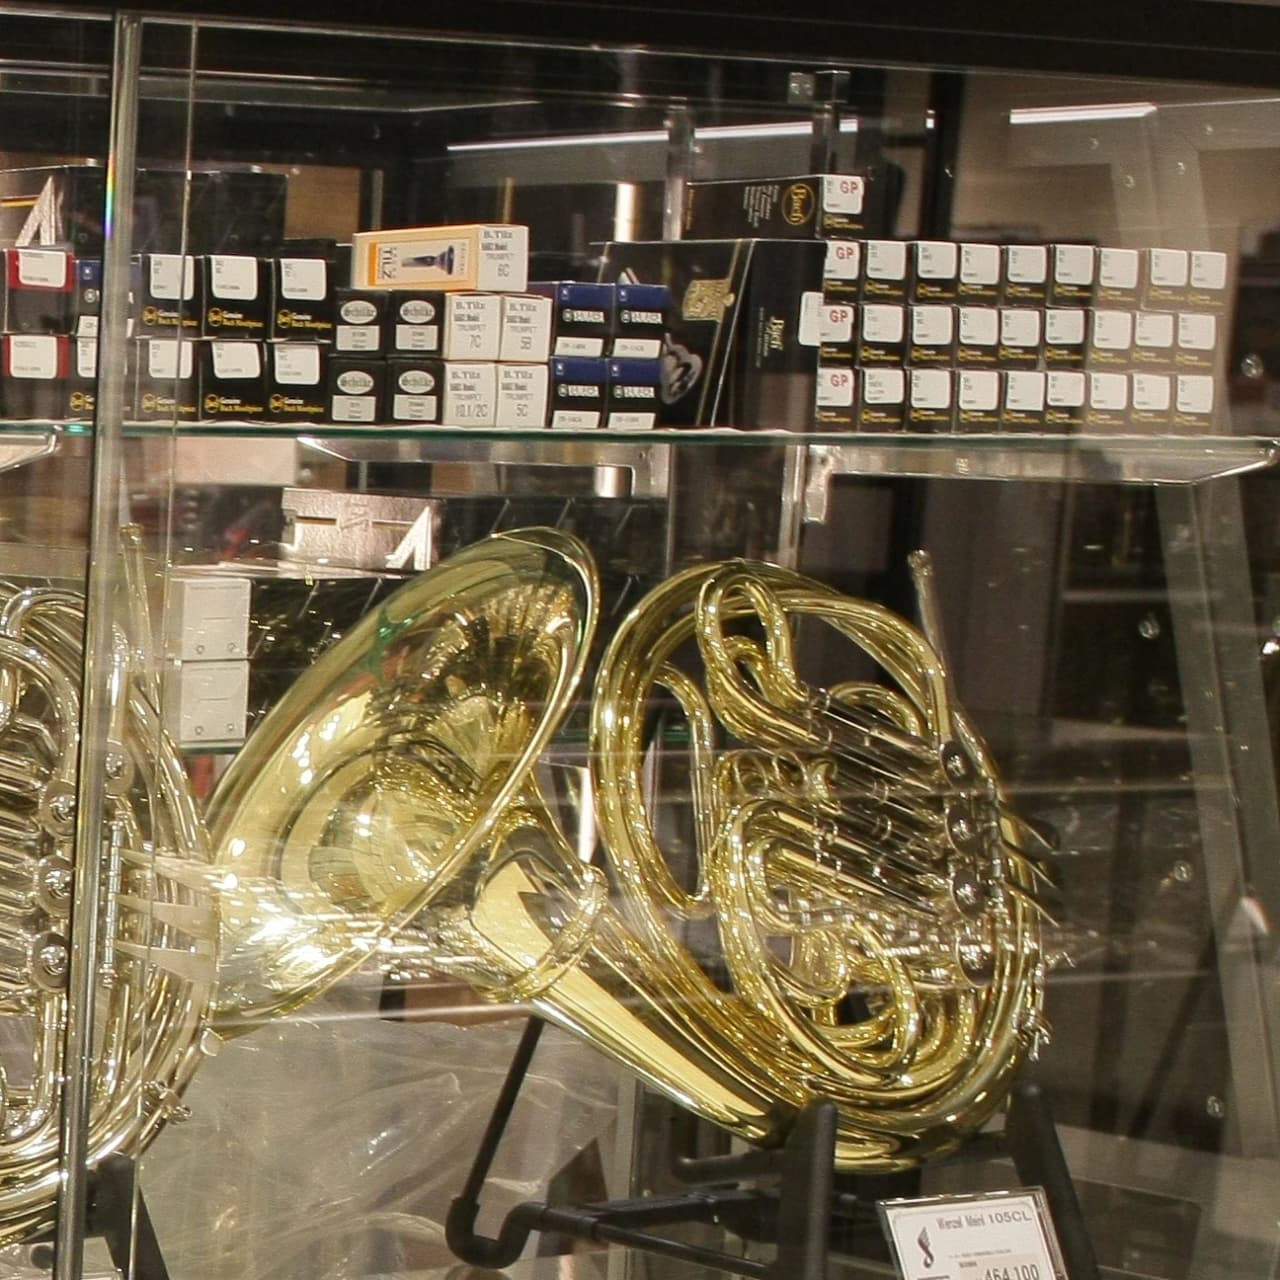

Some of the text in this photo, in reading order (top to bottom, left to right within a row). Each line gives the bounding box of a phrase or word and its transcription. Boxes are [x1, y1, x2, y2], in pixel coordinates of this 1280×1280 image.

[840, 181, 858, 194] GP
[792, 185, 806, 222] Bach
[836, 247, 854, 260] GP
[830, 310, 848, 323] GP
[830, 375, 848, 387] GP
